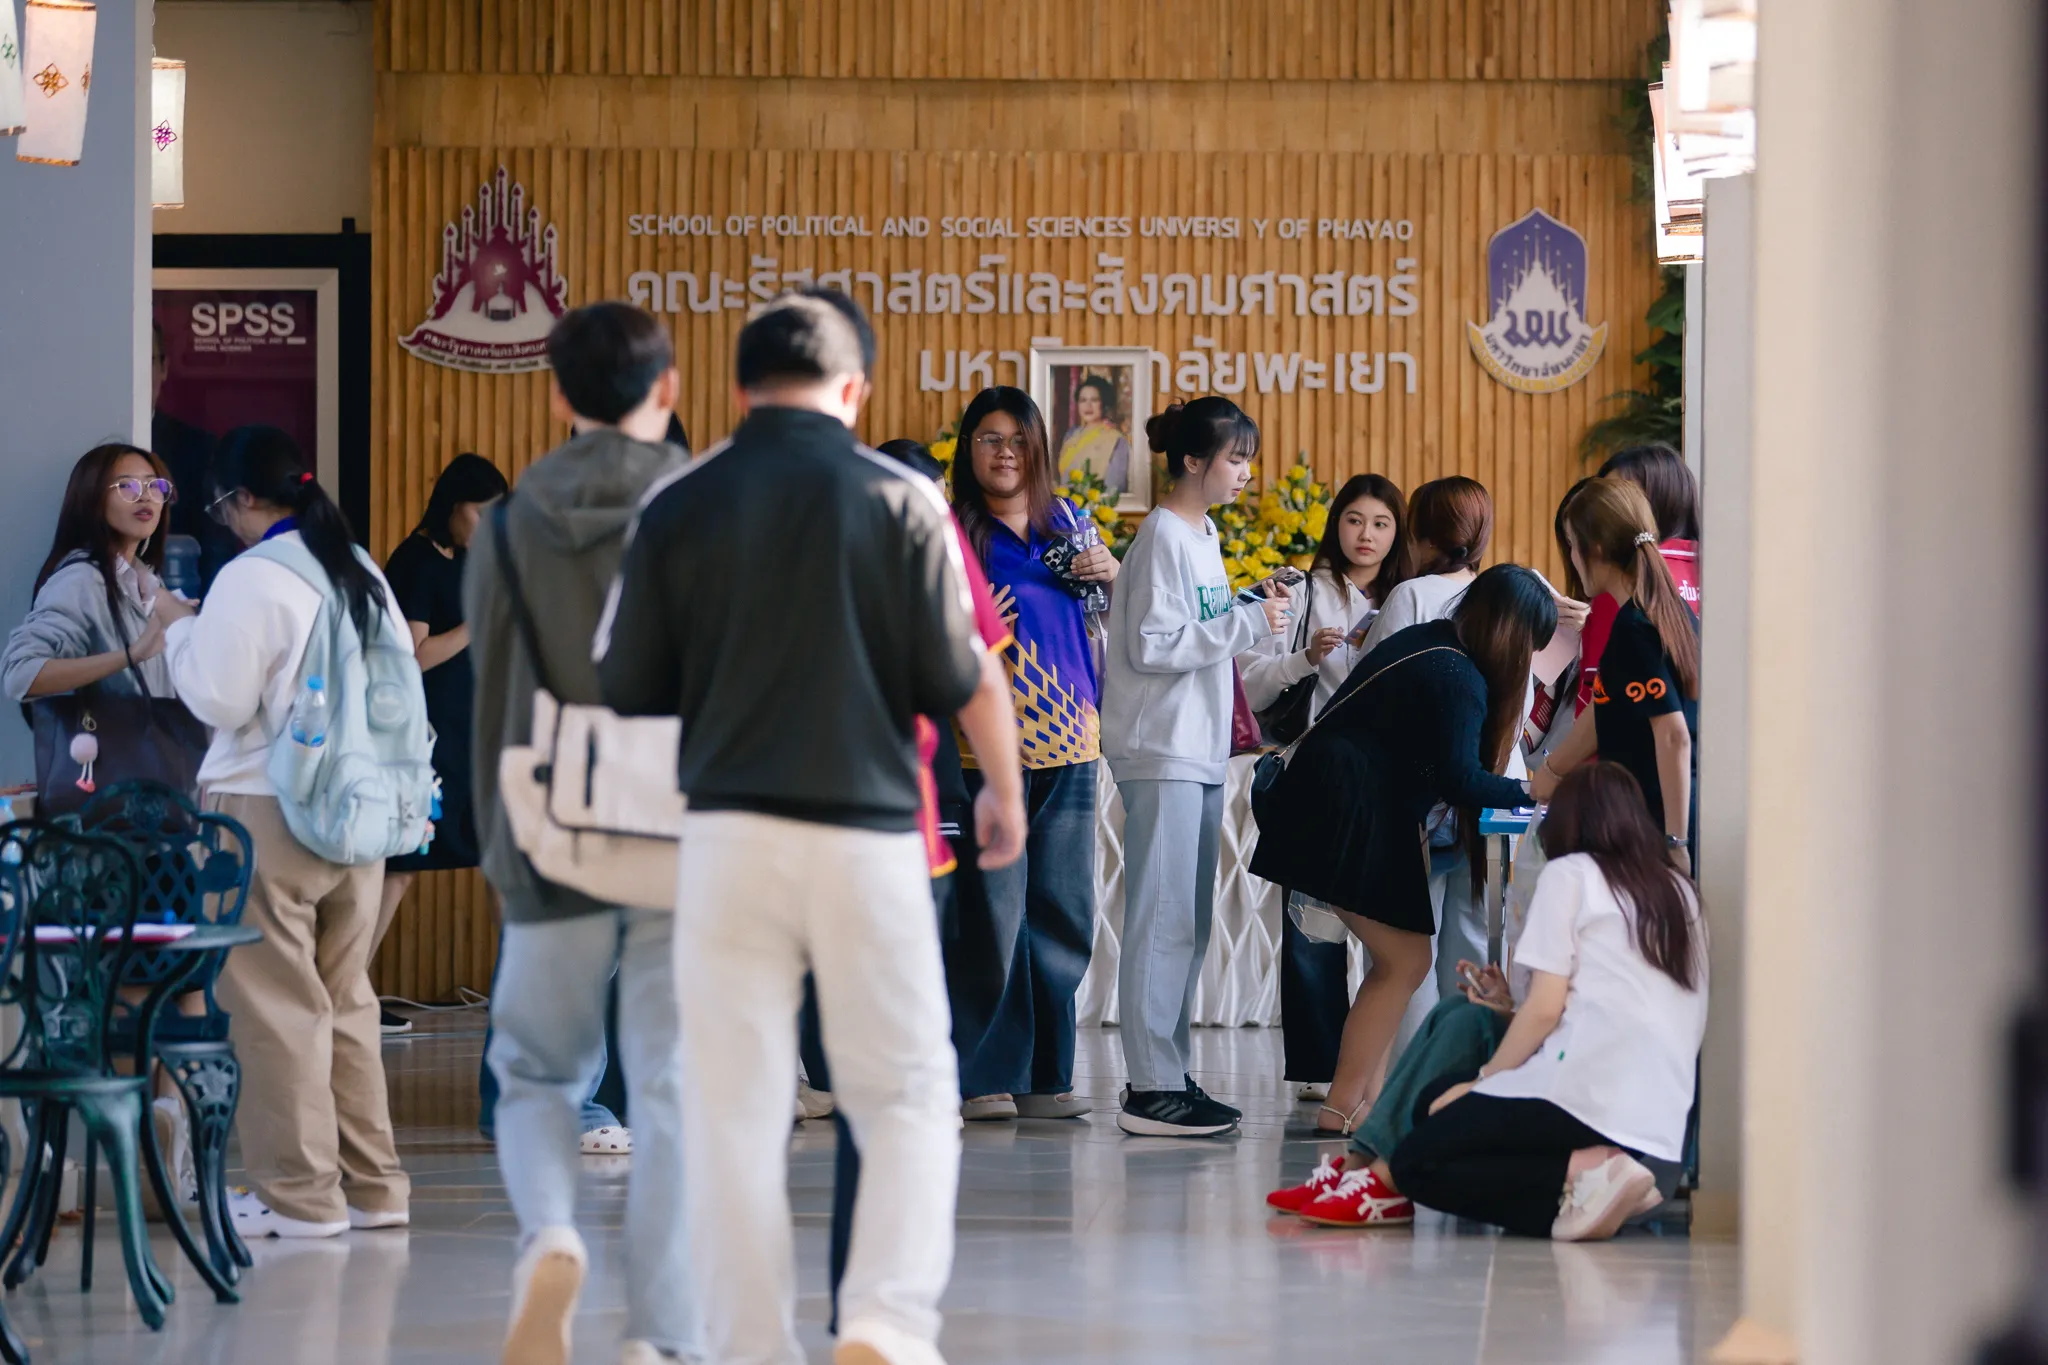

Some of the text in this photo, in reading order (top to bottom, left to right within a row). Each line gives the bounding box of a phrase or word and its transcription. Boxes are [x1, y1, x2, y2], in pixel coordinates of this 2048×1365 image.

[628, 214, 719, 236] SCHOOL
[725, 215, 755, 236] OF
[761, 215, 871, 237] POLITICAL
[882, 216, 930, 238] AND
[940, 216, 1019, 238] SOCIAL
[1026, 216, 1132, 238] SCIENCES
[1278, 217, 1308, 239] OF
[1317, 218, 1413, 241] PHAYAO
[627, 252, 1419, 316] คณะรัศาสตร์และสังคมศาสตร์
[191, 302, 296, 337] SPSS
